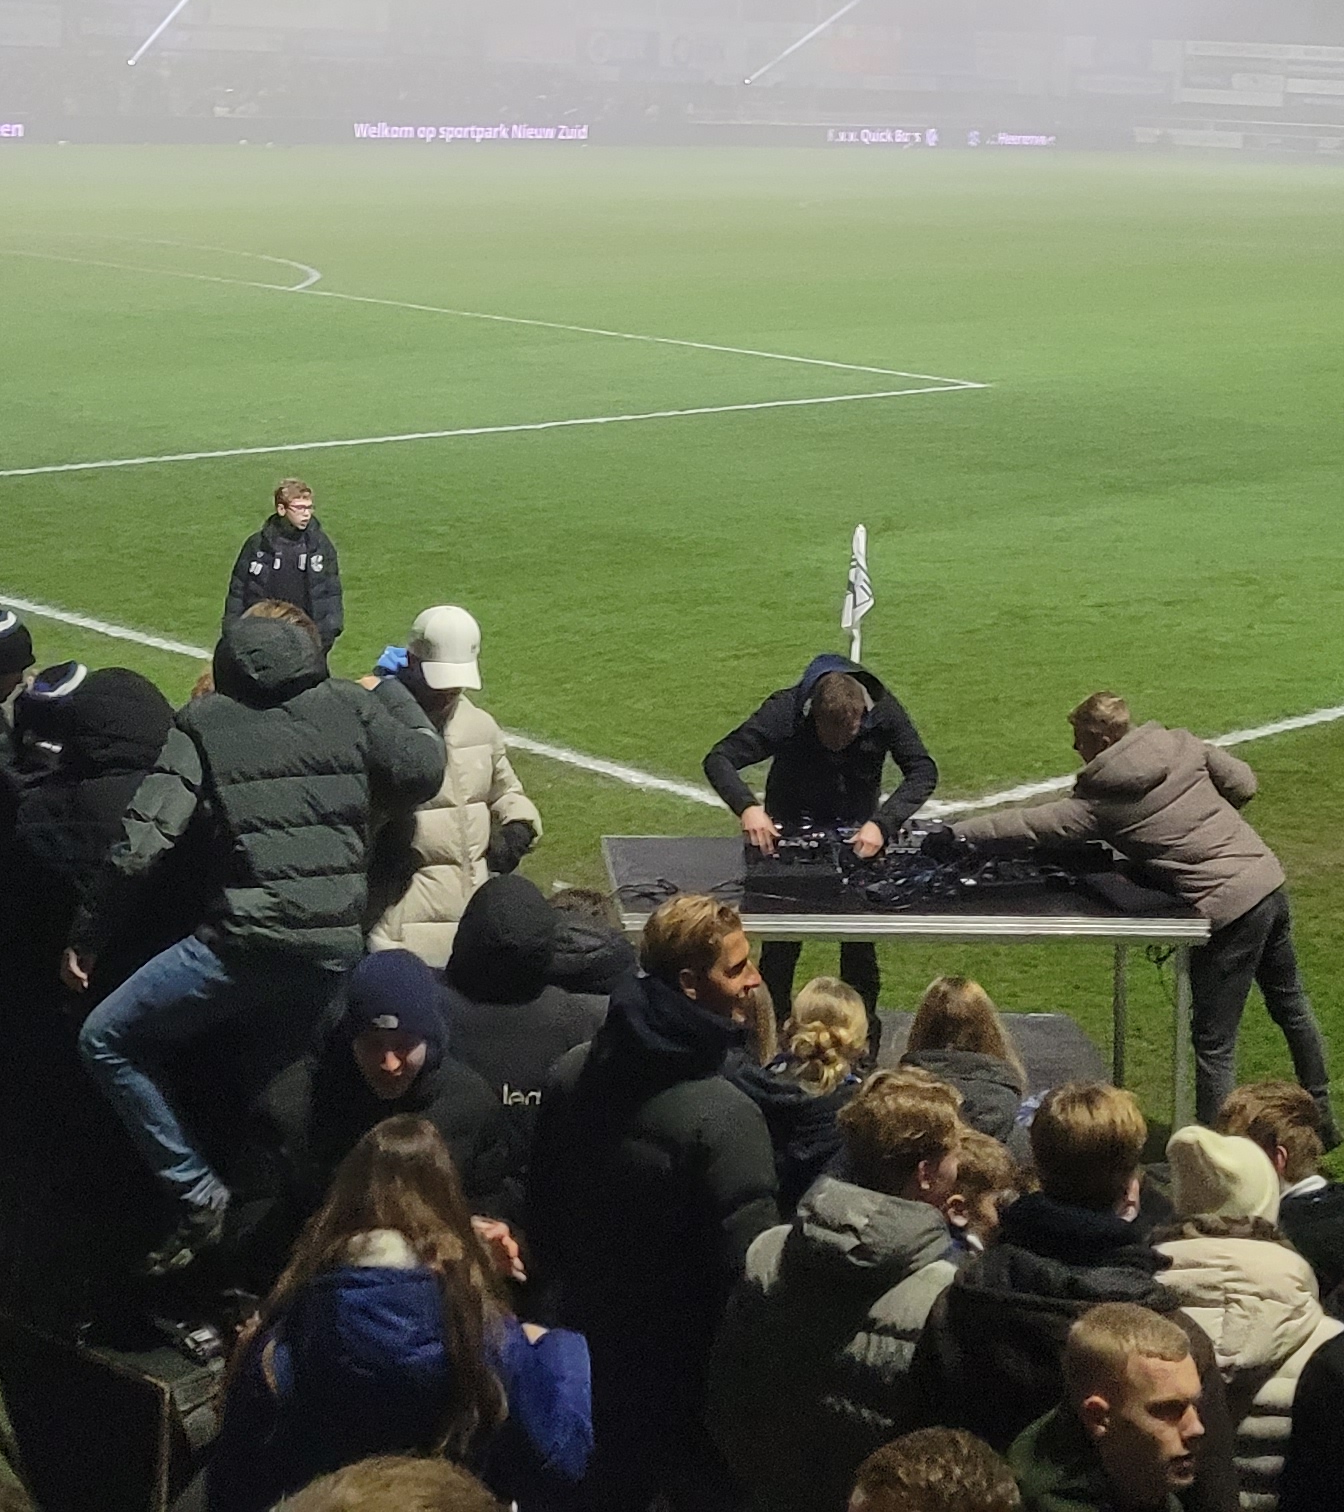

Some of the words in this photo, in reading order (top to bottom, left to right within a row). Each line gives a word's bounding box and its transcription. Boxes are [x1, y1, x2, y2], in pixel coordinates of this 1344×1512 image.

[354, 122, 415, 139] Welkom
[417, 126, 437, 143] op
[438, 123, 510, 143] sportpark
[511, 123, 556, 139] Nieuw
[557, 124, 589, 140] Zuid
[860, 129, 893, 145] Quick
